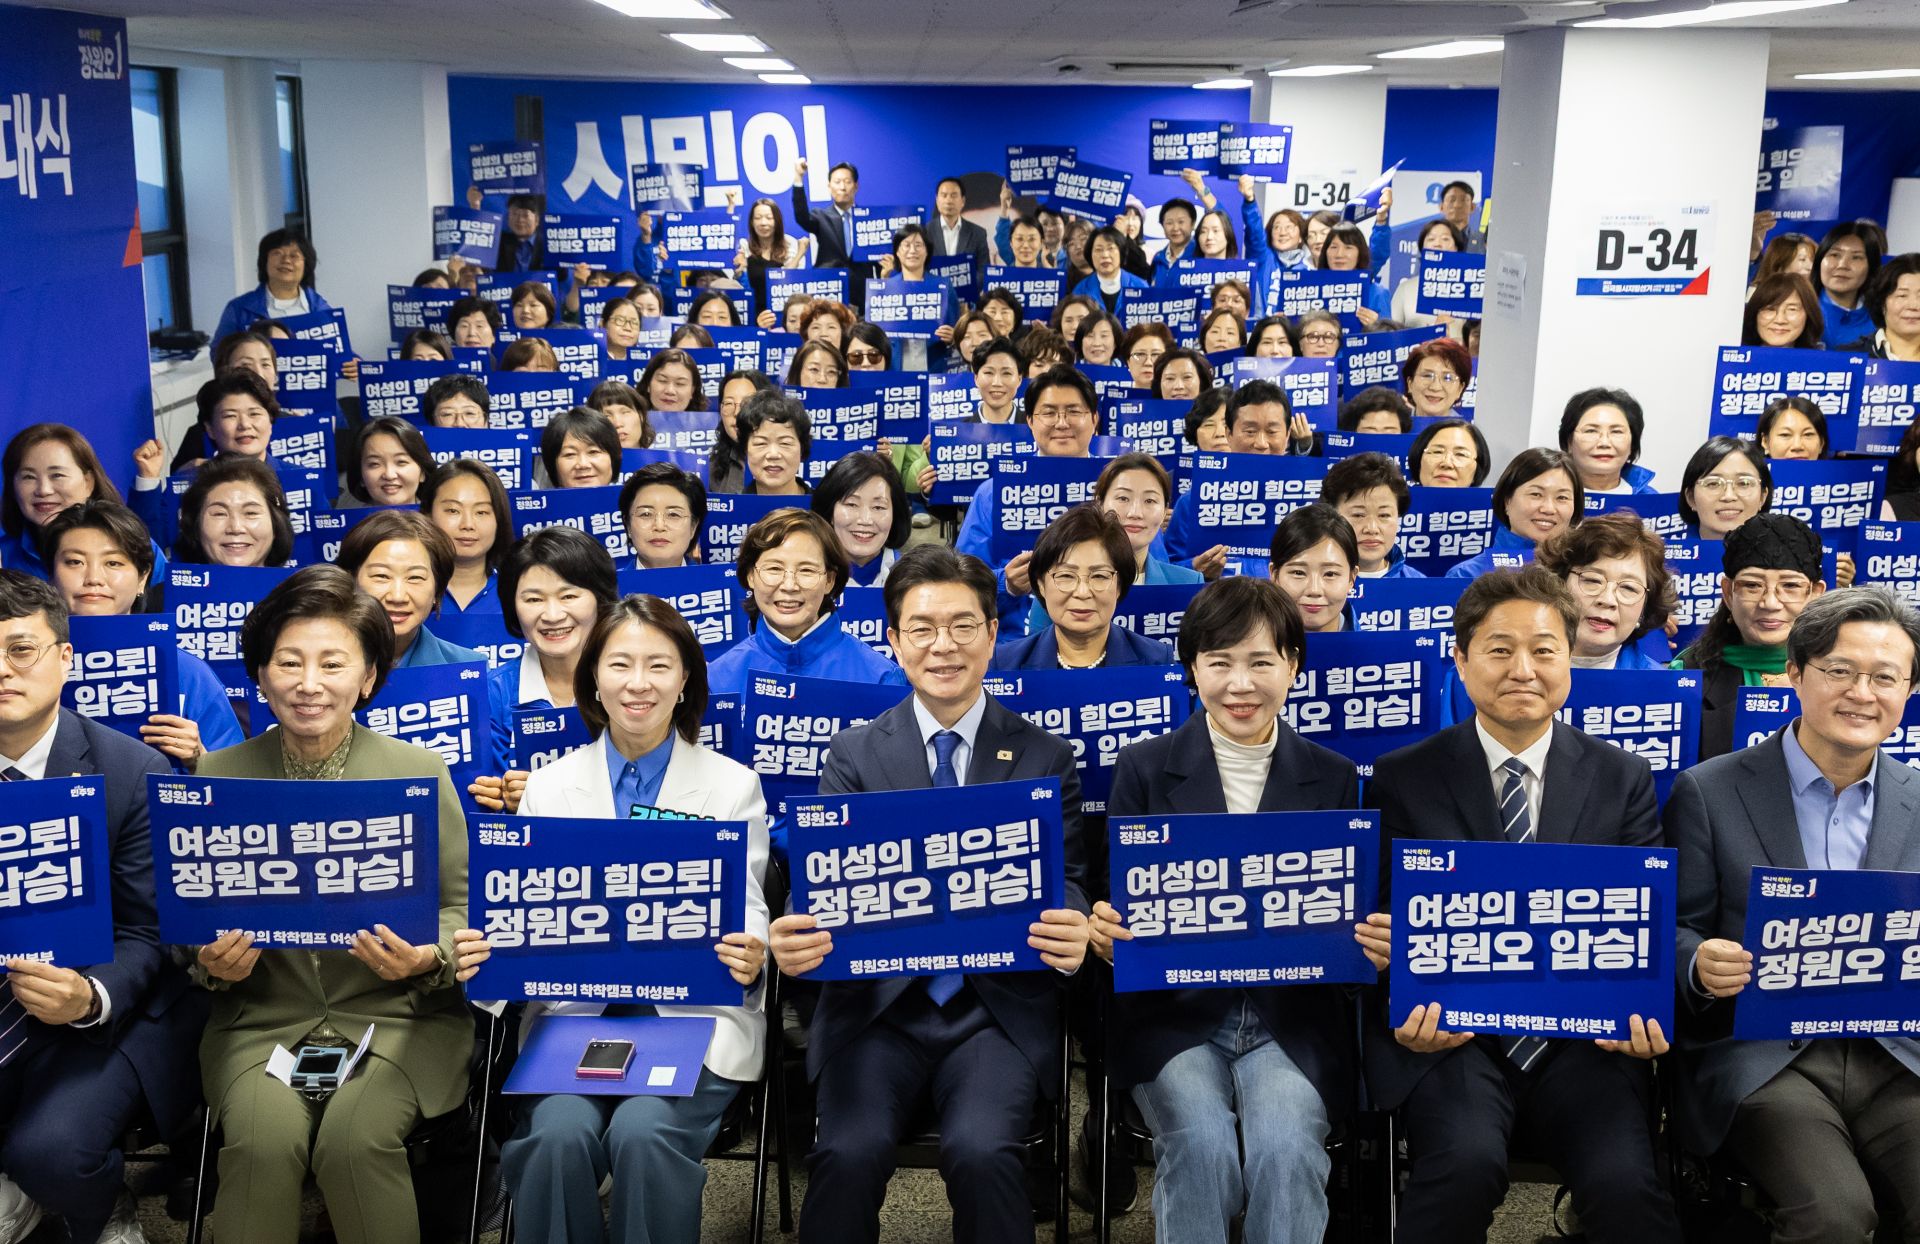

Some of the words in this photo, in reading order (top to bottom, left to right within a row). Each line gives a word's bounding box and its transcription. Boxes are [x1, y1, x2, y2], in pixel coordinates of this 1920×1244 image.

[562, 105, 832, 210] 시민이
[1295, 183, 1350, 206] D-34
[1597, 228, 1698, 272] D-34
[1349, 351, 1391, 368] 여성의
[285, 372, 327, 391] 압승!
[1349, 365, 1399, 386] 정원오
[1722, 372, 1782, 392] 여성의
[1786, 371, 1853, 391] 힘으로!
[366, 380, 410, 398] 여성의
[520, 388, 573, 408] 힘으로!
[930, 388, 966, 405] 여성의
[1292, 388, 1328, 407] 압승!
[367, 396, 419, 417] 정원오
[836, 402, 878, 424] 힘으로!
[884, 401, 921, 420] 압승!
[929, 402, 974, 421] 정원오
[844, 419, 878, 441] 압승!
[1123, 420, 1169, 438] 여성의
[270, 431, 325, 457] 힘으로!
[936, 444, 984, 462] 여성의
[936, 461, 990, 482] 정원오
[1001, 483, 1061, 505] 여성의
[1200, 481, 1259, 501] 여성의
[1810, 481, 1874, 505] 힘으로!
[1198, 502, 1266, 526] 정원오
[1429, 509, 1494, 531] 힘으로!
[1820, 502, 1873, 529] 압승!
[1439, 532, 1492, 557] 압승!
[171, 574, 202, 587] 정원오
[1326, 660, 1421, 695] 힘으로!
[74, 678, 159, 719] 압승!
[755, 682, 787, 698] 정원오
[367, 694, 469, 736] 힘으로!
[1080, 695, 1171, 733] 힘으로!
[1343, 693, 1421, 730] 압승!
[1745, 699, 1780, 712] 정원오
[521, 722, 558, 735] 정원오
[755, 714, 839, 743] 여성의
[1583, 703, 1681, 735] 힘으로!
[70, 786, 96, 798] 민주당
[159, 790, 202, 805] 정원오
[406, 787, 429, 797] 민주당
[1031, 788, 1053, 800] 민주당
[797, 812, 838, 827] 정원오
[1349, 818, 1372, 829] 민주당
[168, 823, 278, 857] 여성의
[290, 813, 413, 854] 힘으로!
[479, 830, 520, 846] 정원오
[716, 829, 739, 841] 민주당
[1120, 831, 1160, 845] 정원오
[806, 839, 911, 884] 여성의
[924, 818, 1039, 870] 힘으로!
[1126, 858, 1229, 896] 여성의
[1240, 846, 1355, 888] 힘으로!
[1403, 855, 1445, 871] 정원오
[1645, 856, 1668, 869] 민주당
[171, 860, 300, 897] 정원오
[315, 850, 413, 894] 압승!
[485, 865, 591, 903] 여성의
[604, 859, 722, 898] 힘으로!
[808, 877, 933, 928] 정원오
[947, 859, 1042, 912] 압승!
[1761, 883, 1804, 898] 정원오
[1128, 894, 1247, 938] 정원오
[1262, 883, 1355, 928] 압승!
[1408, 891, 1516, 928] 여성의
[1528, 887, 1650, 924] 힘으로!
[484, 904, 610, 948] 정원오
[625, 899, 721, 942] 압승!
[1762, 913, 1873, 949] 여성의
[273, 930, 327, 944] 착착캠프
[1407, 931, 1534, 975] 정원오
[1550, 928, 1650, 970] 압승!
[850, 959, 903, 974] 정원오의
[906, 955, 959, 971] 착착캠프
[962, 952, 1015, 968] 여성본부
[1758, 947, 1885, 990] 정원오
[1165, 969, 1217, 983] 정원오의
[1219, 968, 1270, 982] 착착캠프
[1273, 966, 1324, 980] 여성본부
[524, 982, 577, 996] 정원오의
[580, 983, 633, 998] 착착캠프
[636, 986, 689, 1000] 여성본부
[1445, 1010, 1500, 1028] 정원오의
[1503, 1014, 1558, 1031] 착착캠프
[1561, 1017, 1616, 1034] 여성본부
[1790, 1021, 1842, 1035] 정원오의
[1846, 1020, 1899, 1033] 착착캠프
